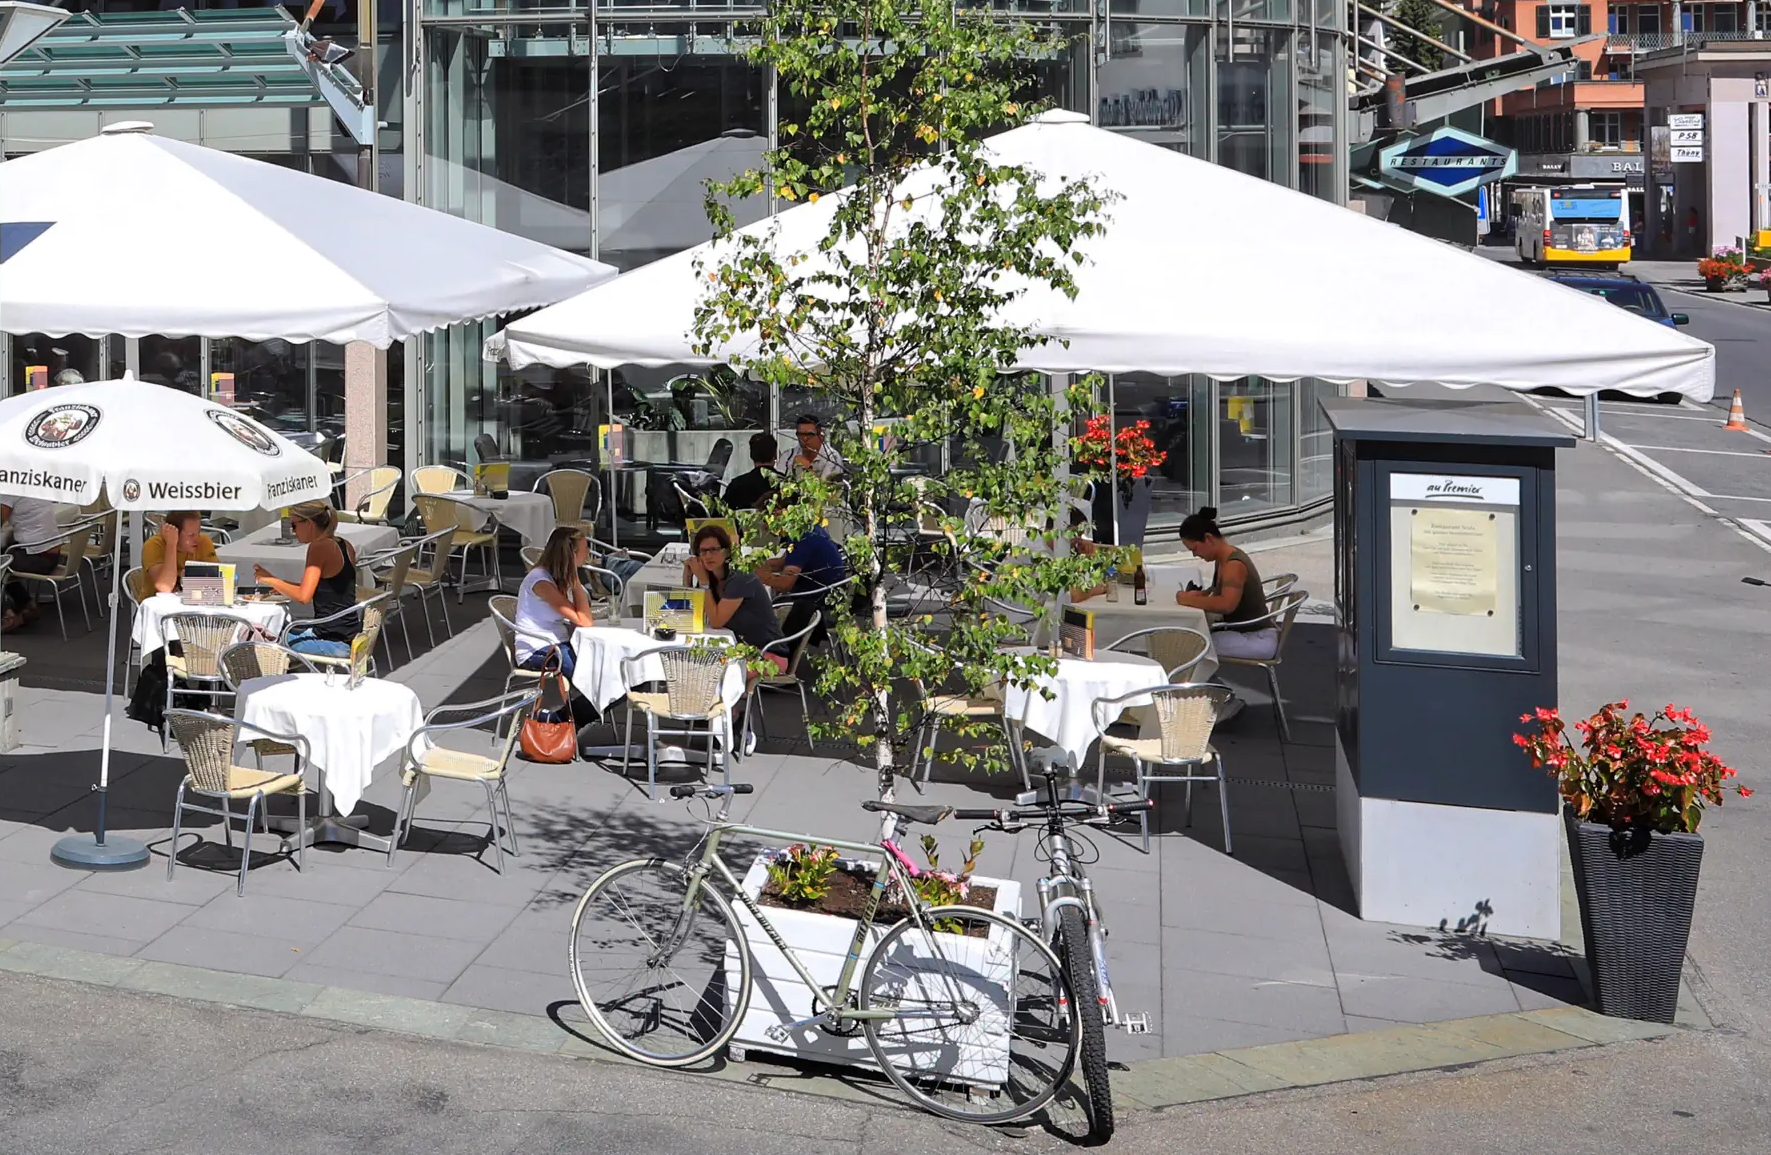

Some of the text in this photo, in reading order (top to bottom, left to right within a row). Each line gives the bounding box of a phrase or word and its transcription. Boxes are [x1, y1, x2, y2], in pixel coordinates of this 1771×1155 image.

[1389, 157, 1507, 167] RESTAURANTS
[1612, 162, 1644, 172] BAL
[148, 480, 243, 500] Weissbier
[1426, 479, 1483, 494] au Premier
